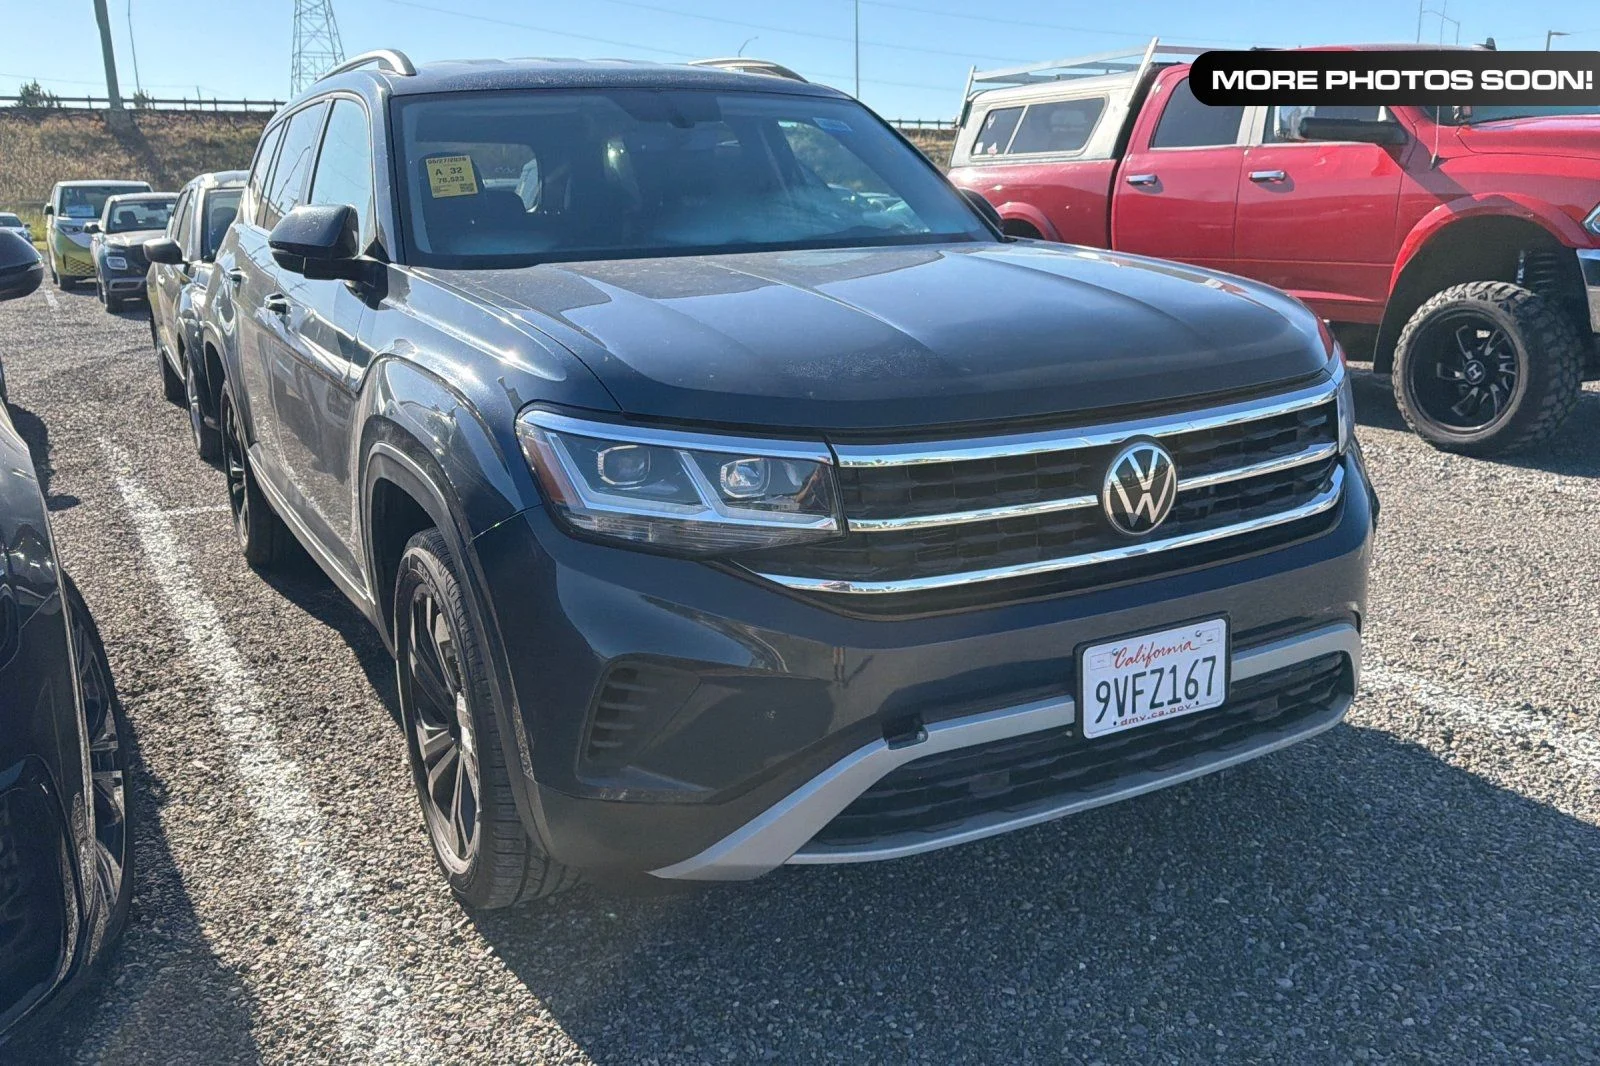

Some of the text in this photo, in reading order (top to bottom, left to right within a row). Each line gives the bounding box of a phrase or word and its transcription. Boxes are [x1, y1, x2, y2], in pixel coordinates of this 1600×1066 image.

[435, 166, 463, 176] A 32
[1114, 638, 1200, 669] California
[1095, 655, 1216, 724] 9VFZ167
[1120, 703, 1193, 727] dmv.ca.gov
